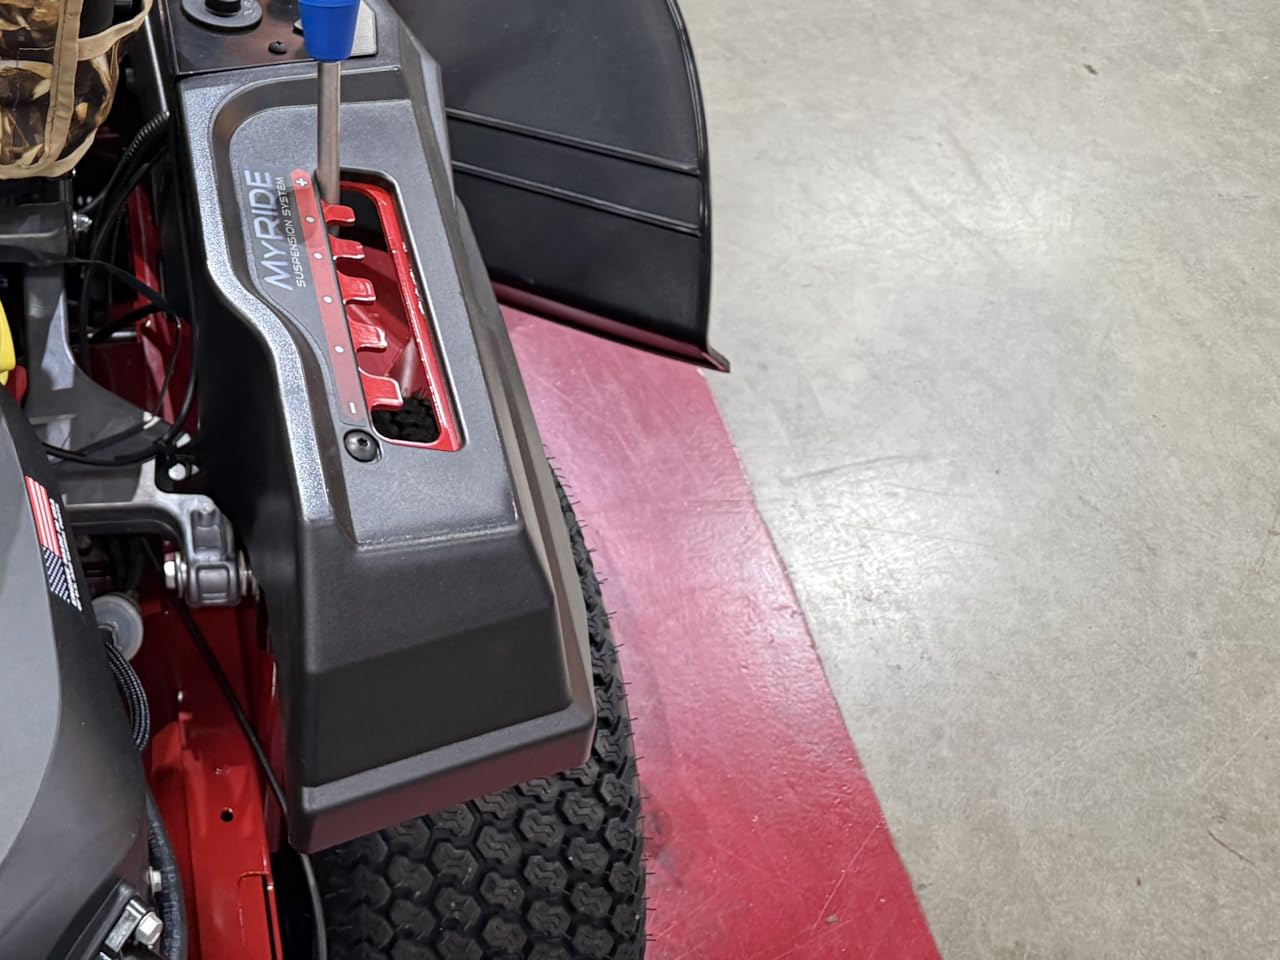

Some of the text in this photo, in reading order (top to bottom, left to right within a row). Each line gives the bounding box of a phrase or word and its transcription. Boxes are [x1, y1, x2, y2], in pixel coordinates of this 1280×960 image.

[243, 169, 294, 291] MYRIDE
[275, 176, 307, 288] SUSPENSION SYSTEM
